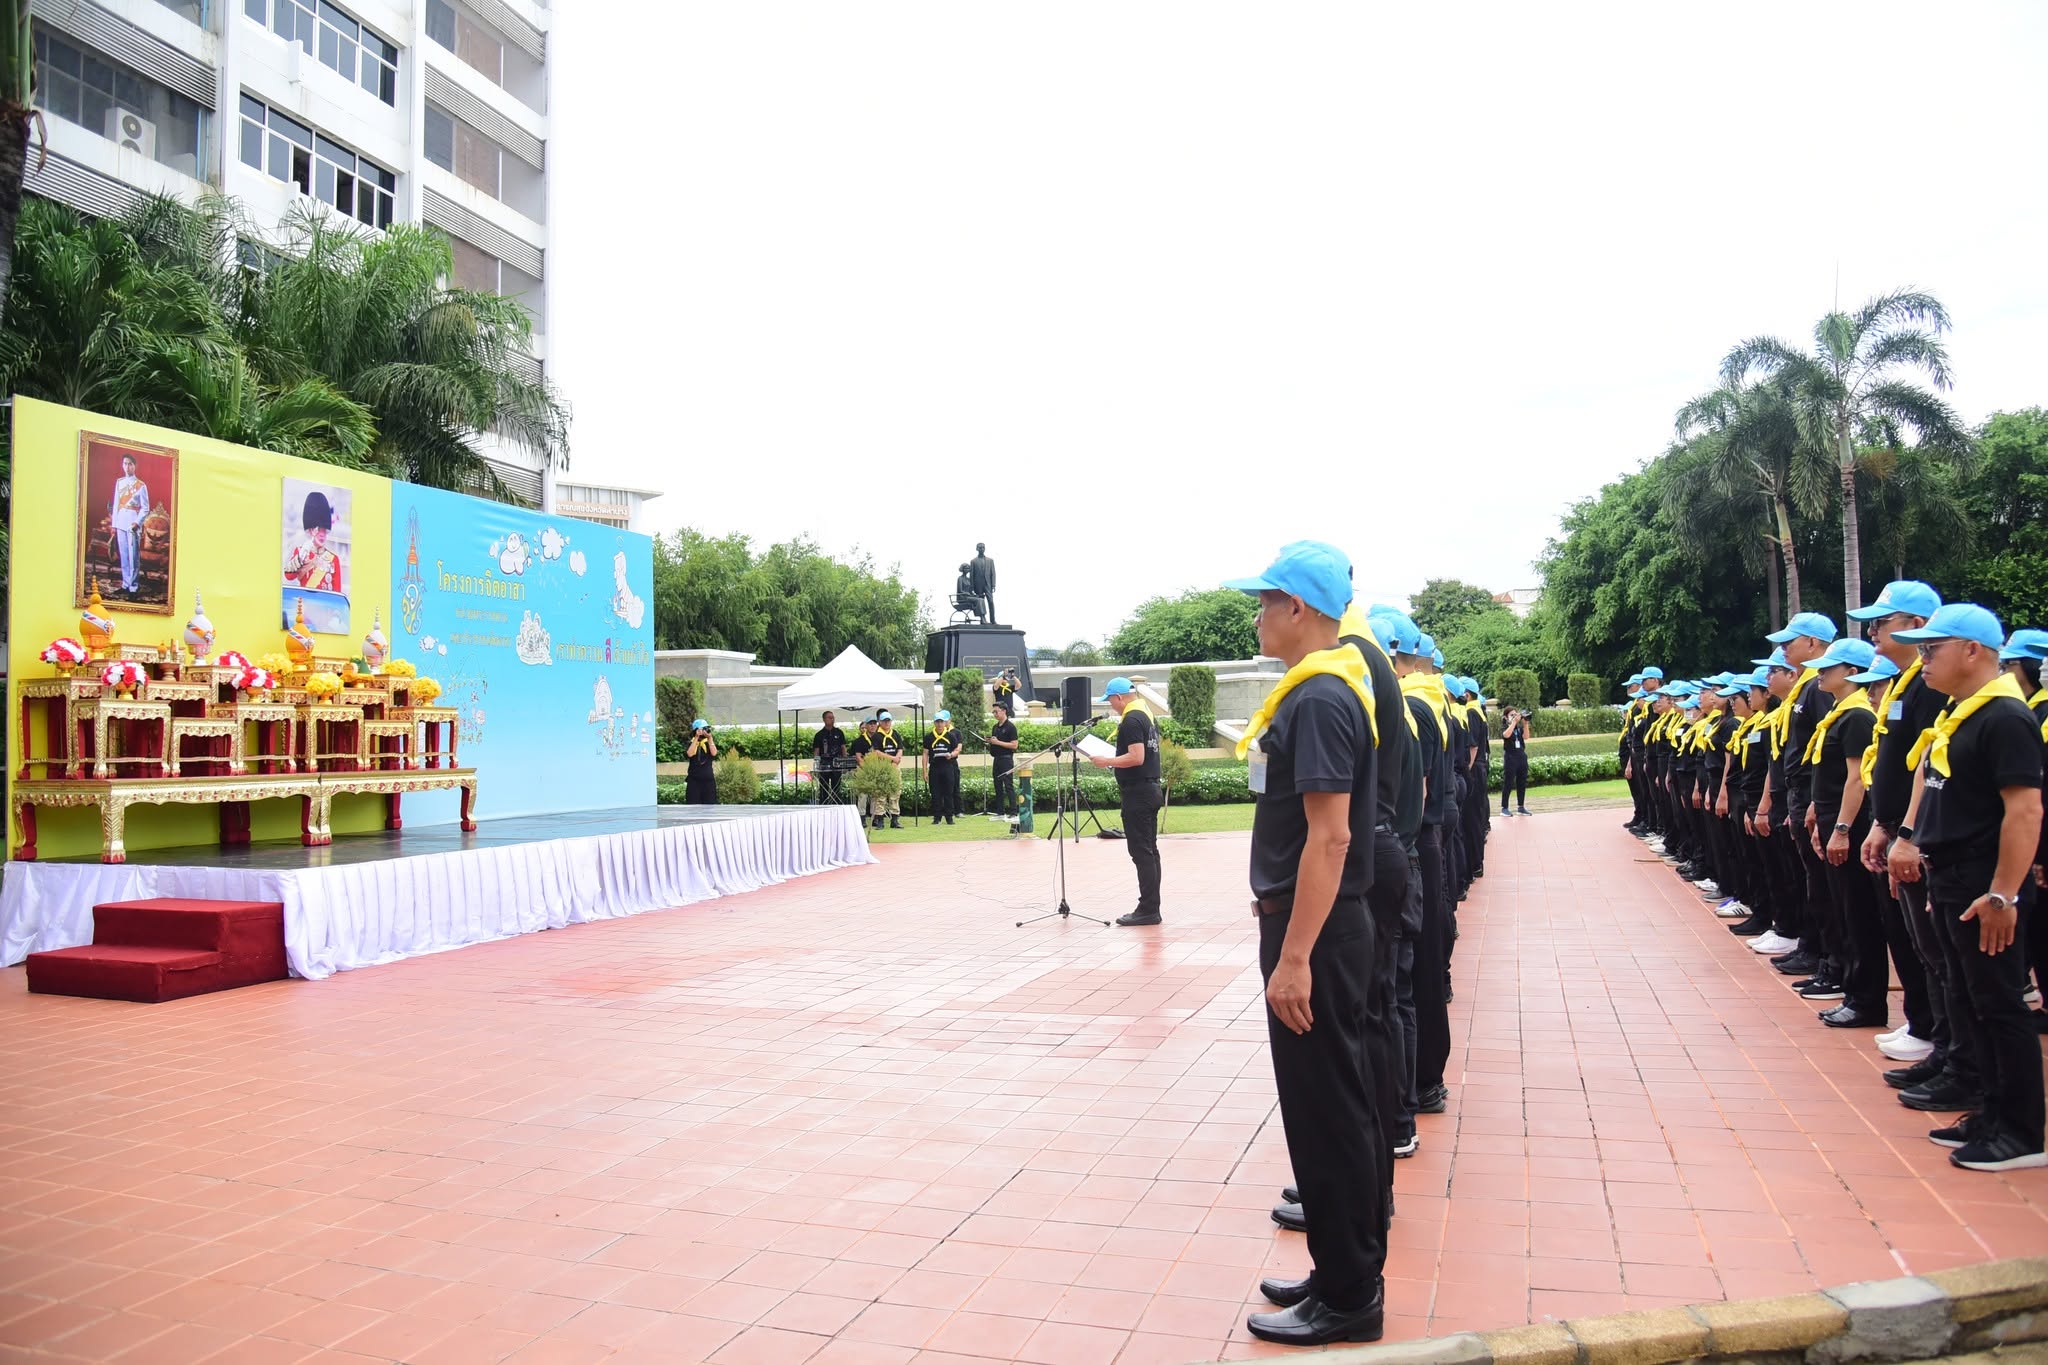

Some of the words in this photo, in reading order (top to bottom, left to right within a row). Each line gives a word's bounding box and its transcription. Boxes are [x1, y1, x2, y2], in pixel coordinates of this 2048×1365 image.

[437, 559, 525, 601] โครงการจิตอาสา
